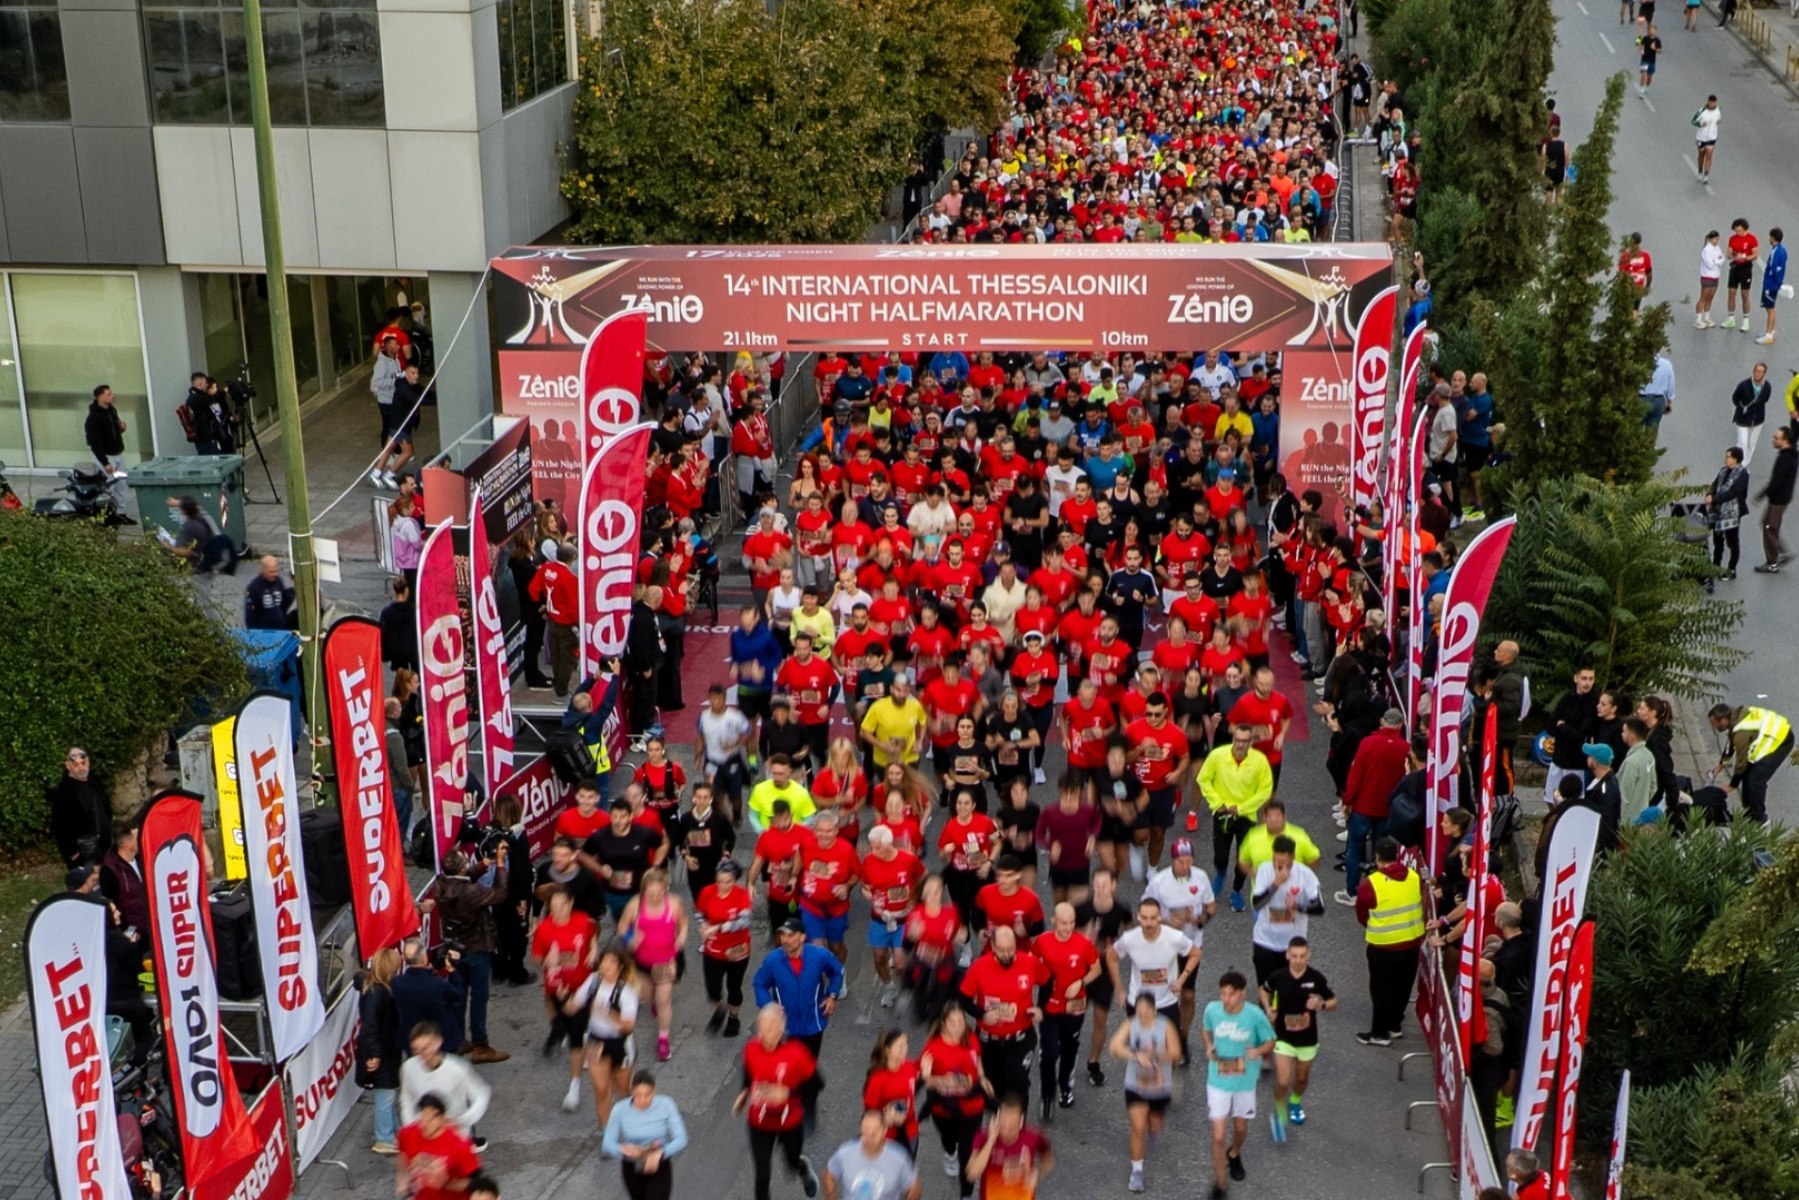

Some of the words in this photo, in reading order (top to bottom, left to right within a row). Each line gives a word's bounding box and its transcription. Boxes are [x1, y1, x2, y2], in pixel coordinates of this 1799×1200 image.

[762, 275, 961, 296] INTERNATIONAL
[967, 274, 1148, 295] THESSALONIKI
[786, 302, 866, 323] NIGHT
[871, 301, 1084, 322] HALFMARATHON
[723, 331, 779, 346] 21.1km
[902, 333, 969, 345] START
[1102, 331, 1149, 346] 10km
[250, 745, 308, 1012] SUPERBET
[167, 870, 196, 978] SUPER
